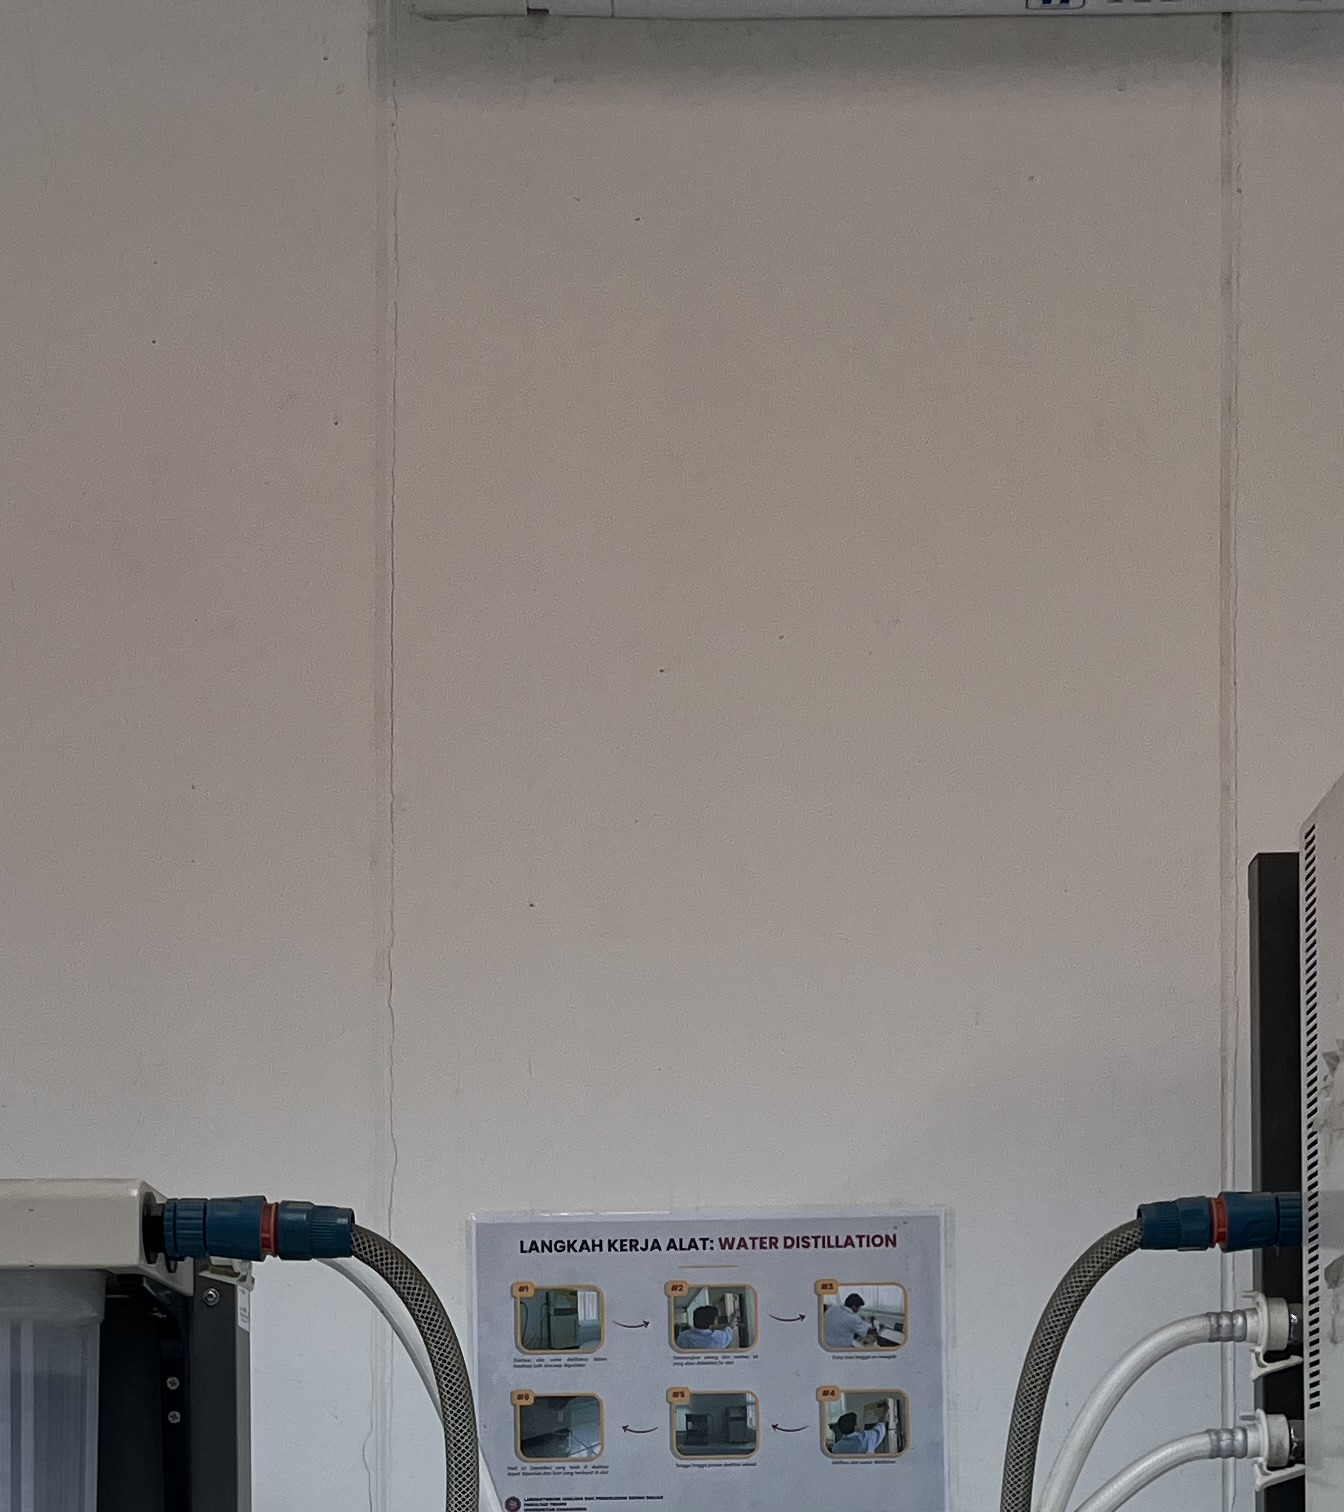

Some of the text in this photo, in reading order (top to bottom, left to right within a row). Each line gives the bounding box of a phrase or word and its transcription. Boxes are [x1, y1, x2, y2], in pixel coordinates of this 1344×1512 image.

[519, 1234, 897, 1254] LANGKAH KERJA ALAT: WATER DISTILLATION
